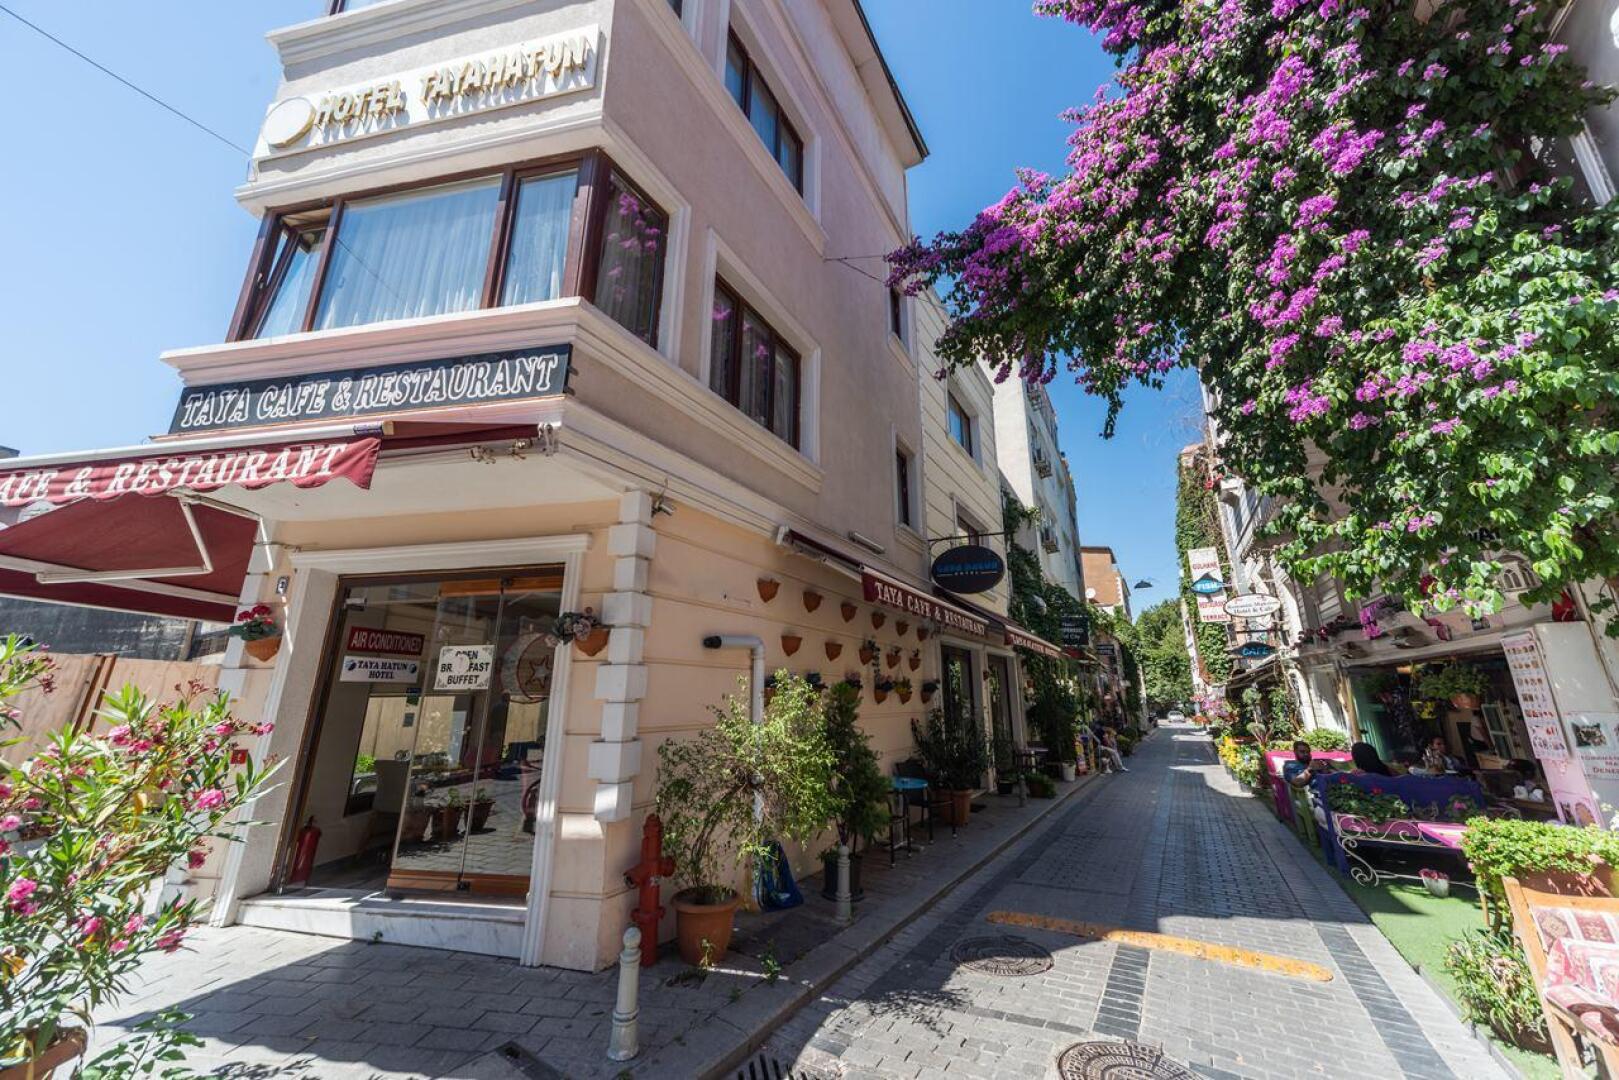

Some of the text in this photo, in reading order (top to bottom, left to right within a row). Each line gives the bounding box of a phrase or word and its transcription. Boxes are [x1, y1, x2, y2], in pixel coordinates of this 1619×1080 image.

[314, 80, 407, 126] HOTEL
[181, 354, 559, 428] TAYA CAFE & RESTAURANT
[64, 466, 95, 497] &
[106, 443, 349, 495] RESTAURANT
[874, 582, 986, 636] TAYA CAFE & RESTAURANT
[350, 631, 423, 652] AIR CONDITIONED
[357, 660, 409, 670] TAYA HATUN
[368, 670, 395, 679] HOTEL
[440, 662, 491, 673] BRFAST
[446, 675, 480, 685] BUFFET
